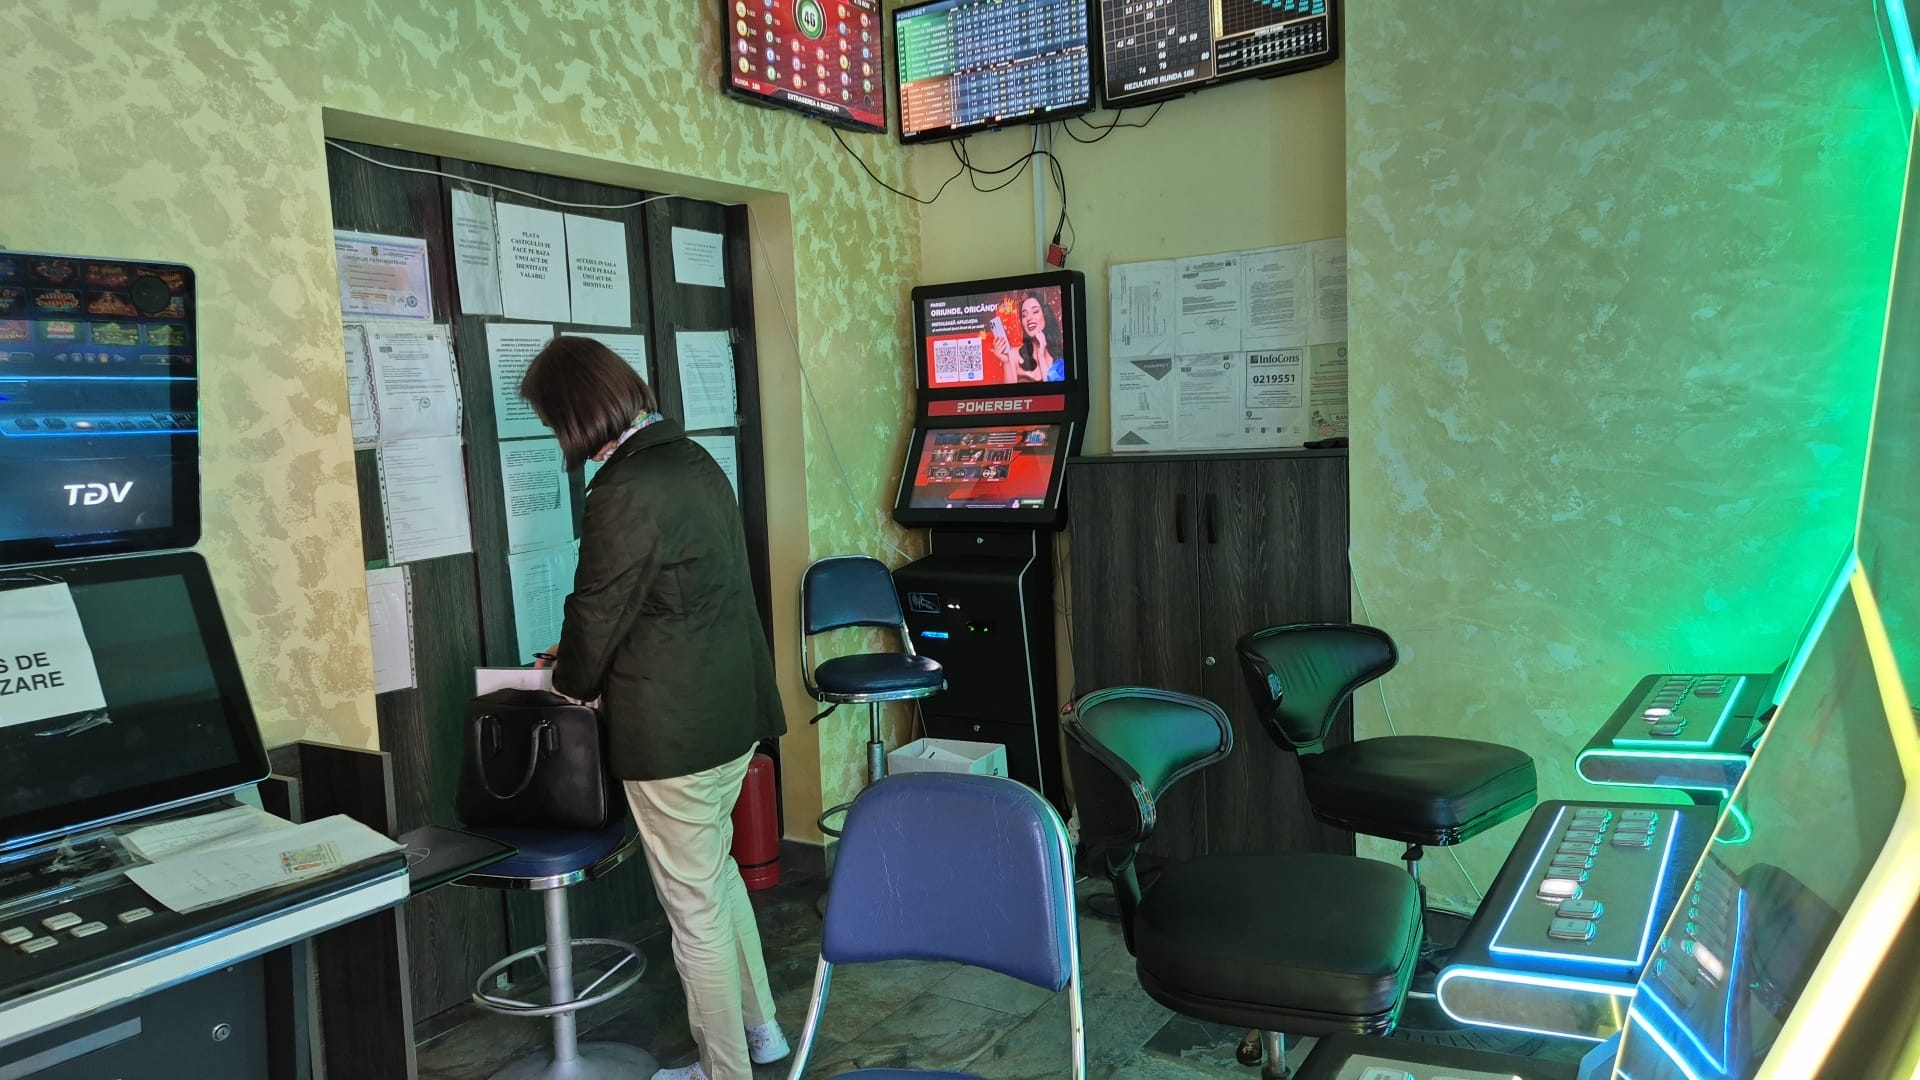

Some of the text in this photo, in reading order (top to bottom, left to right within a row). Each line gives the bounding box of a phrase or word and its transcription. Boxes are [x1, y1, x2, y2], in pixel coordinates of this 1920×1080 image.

[804, 11, 815, 27] 46
[1139, 66, 1146, 74] 74
[1124, 77, 1158, 91] REZULTATE
[1160, 72, 1182, 83] RUNDA
[522, 231, 540, 239] PLATA
[511, 238, 544, 248] CASTIGULUI
[512, 246, 527, 254] FACE
[535, 249, 550, 257] BAZA
[576, 257, 598, 266] ACCESUL
[516, 263, 549, 272] IDENTITATE
[604, 268, 617, 276] BAZA
[520, 271, 546, 280] VALABIL!
[931, 307, 963, 317] ORIUNDE,
[1260, 353, 1300, 364] InfoCons
[1253, 374, 1296, 384] 0219551
[15, 652, 50, 671] DE
